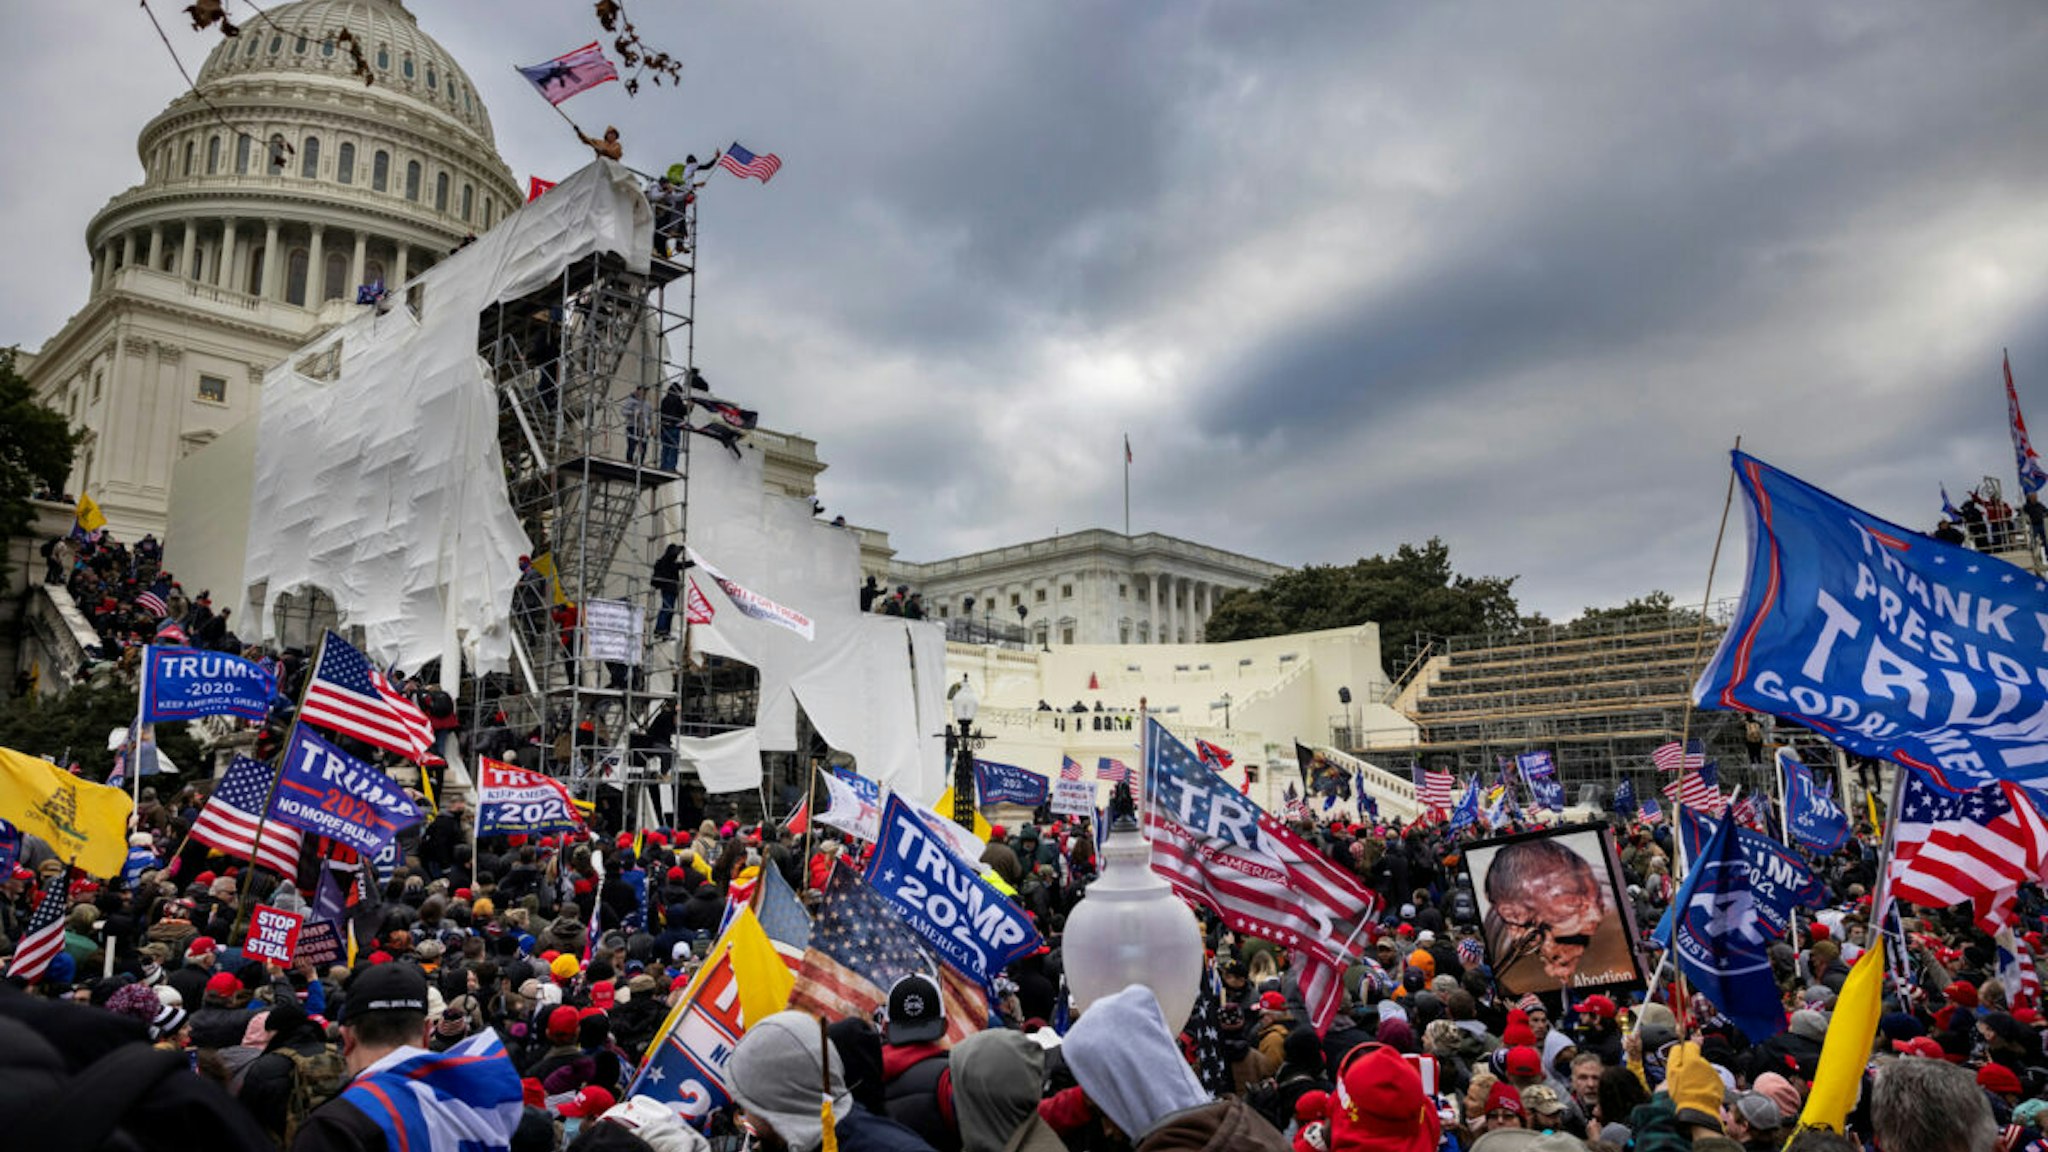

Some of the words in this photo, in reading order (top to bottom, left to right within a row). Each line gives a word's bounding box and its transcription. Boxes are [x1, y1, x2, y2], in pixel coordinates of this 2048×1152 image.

[158, 700, 184, 710] KEEP
[186, 697, 231, 709] AMERICA
[487, 788, 515, 799] KEEP
[277, 797, 301, 816] NO
[299, 804, 343, 830] MORE
[1218, 855, 1289, 887] AMERICA
[896, 815, 1026, 950] TRUMP
[257, 911, 297, 930] STOP
[259, 926, 288, 945] THE
[906, 914, 969, 966] AMERICA
[246, 939, 290, 962] STEAL
[1573, 970, 1633, 988] Abortion
